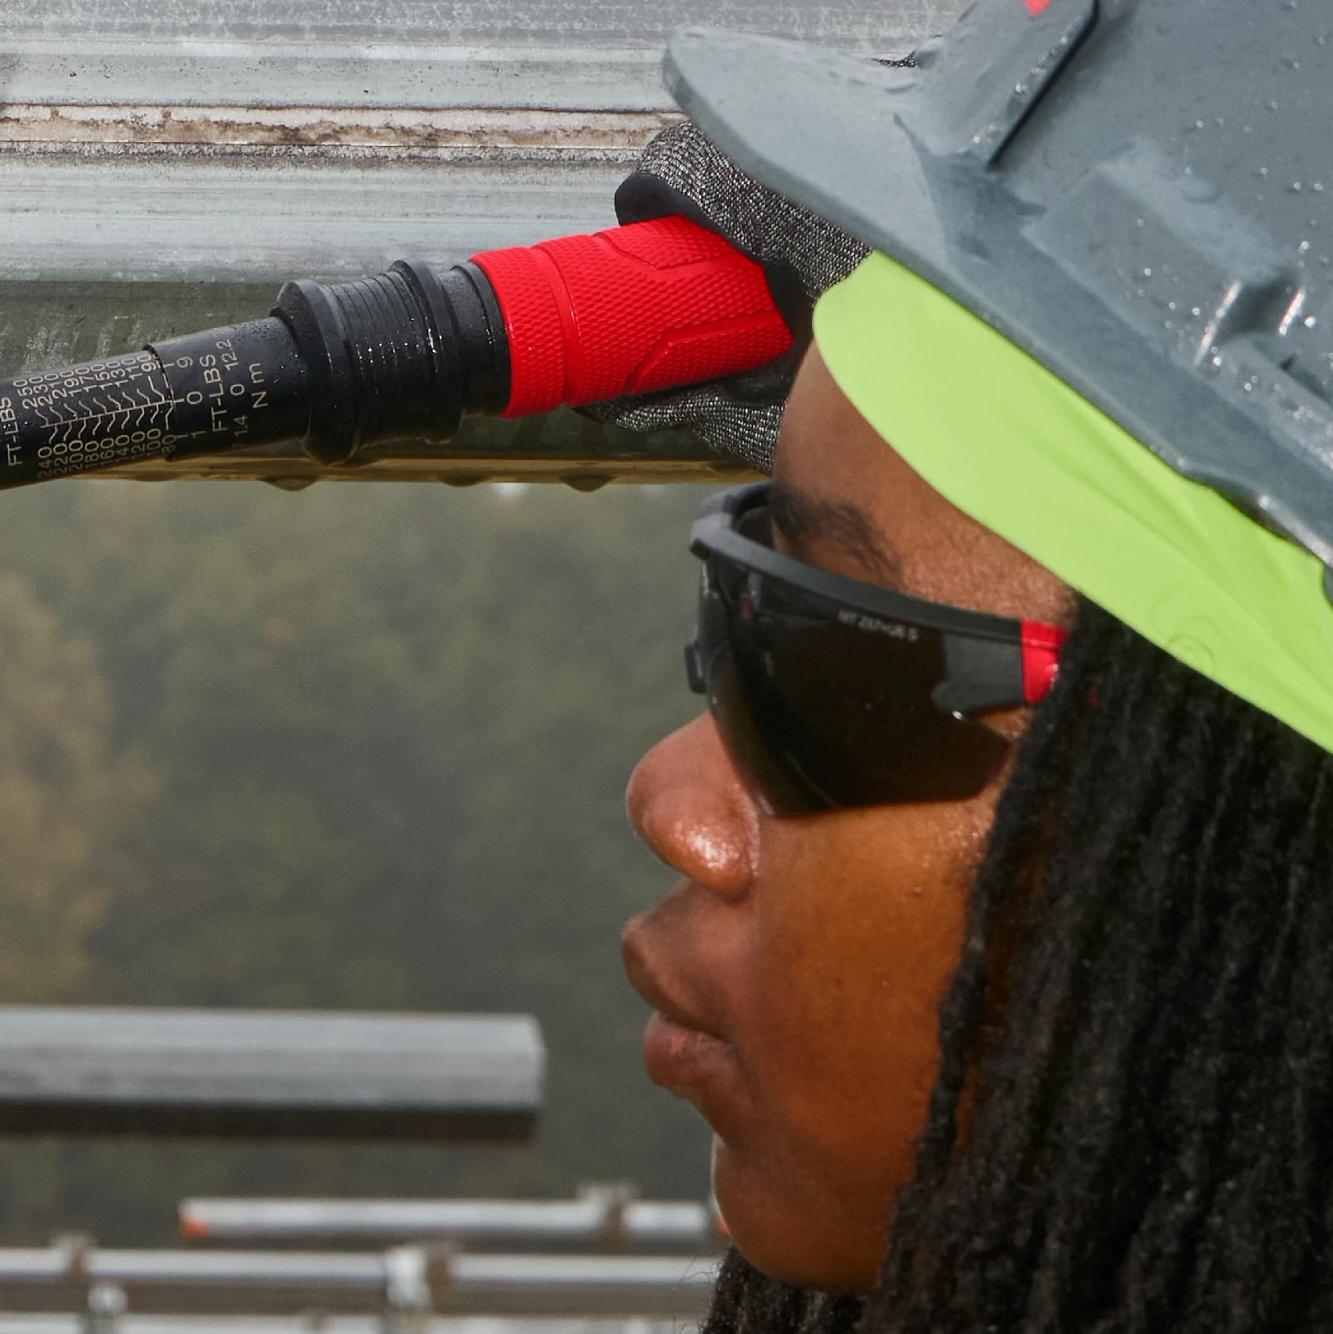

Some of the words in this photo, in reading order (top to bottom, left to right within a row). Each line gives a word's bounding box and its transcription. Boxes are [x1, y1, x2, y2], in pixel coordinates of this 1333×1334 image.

[136, 354, 157, 373] 90
[176, 356, 194, 368] 9
[216, 339, 239, 371] 12.2
[75, 366, 98, 392] 170
[90, 363, 114, 390] 150
[105, 360, 128, 387] 130
[121, 357, 143, 381] 110
[13, 379, 38, 409] 250
[29, 376, 54, 406] 230
[44, 373, 68, 399] 210
[59, 369, 82, 397] 190
[199, 354, 228, 432] FT-LBS
[230, 383, 245, 396] 0
[186, 391, 203, 405] 0
